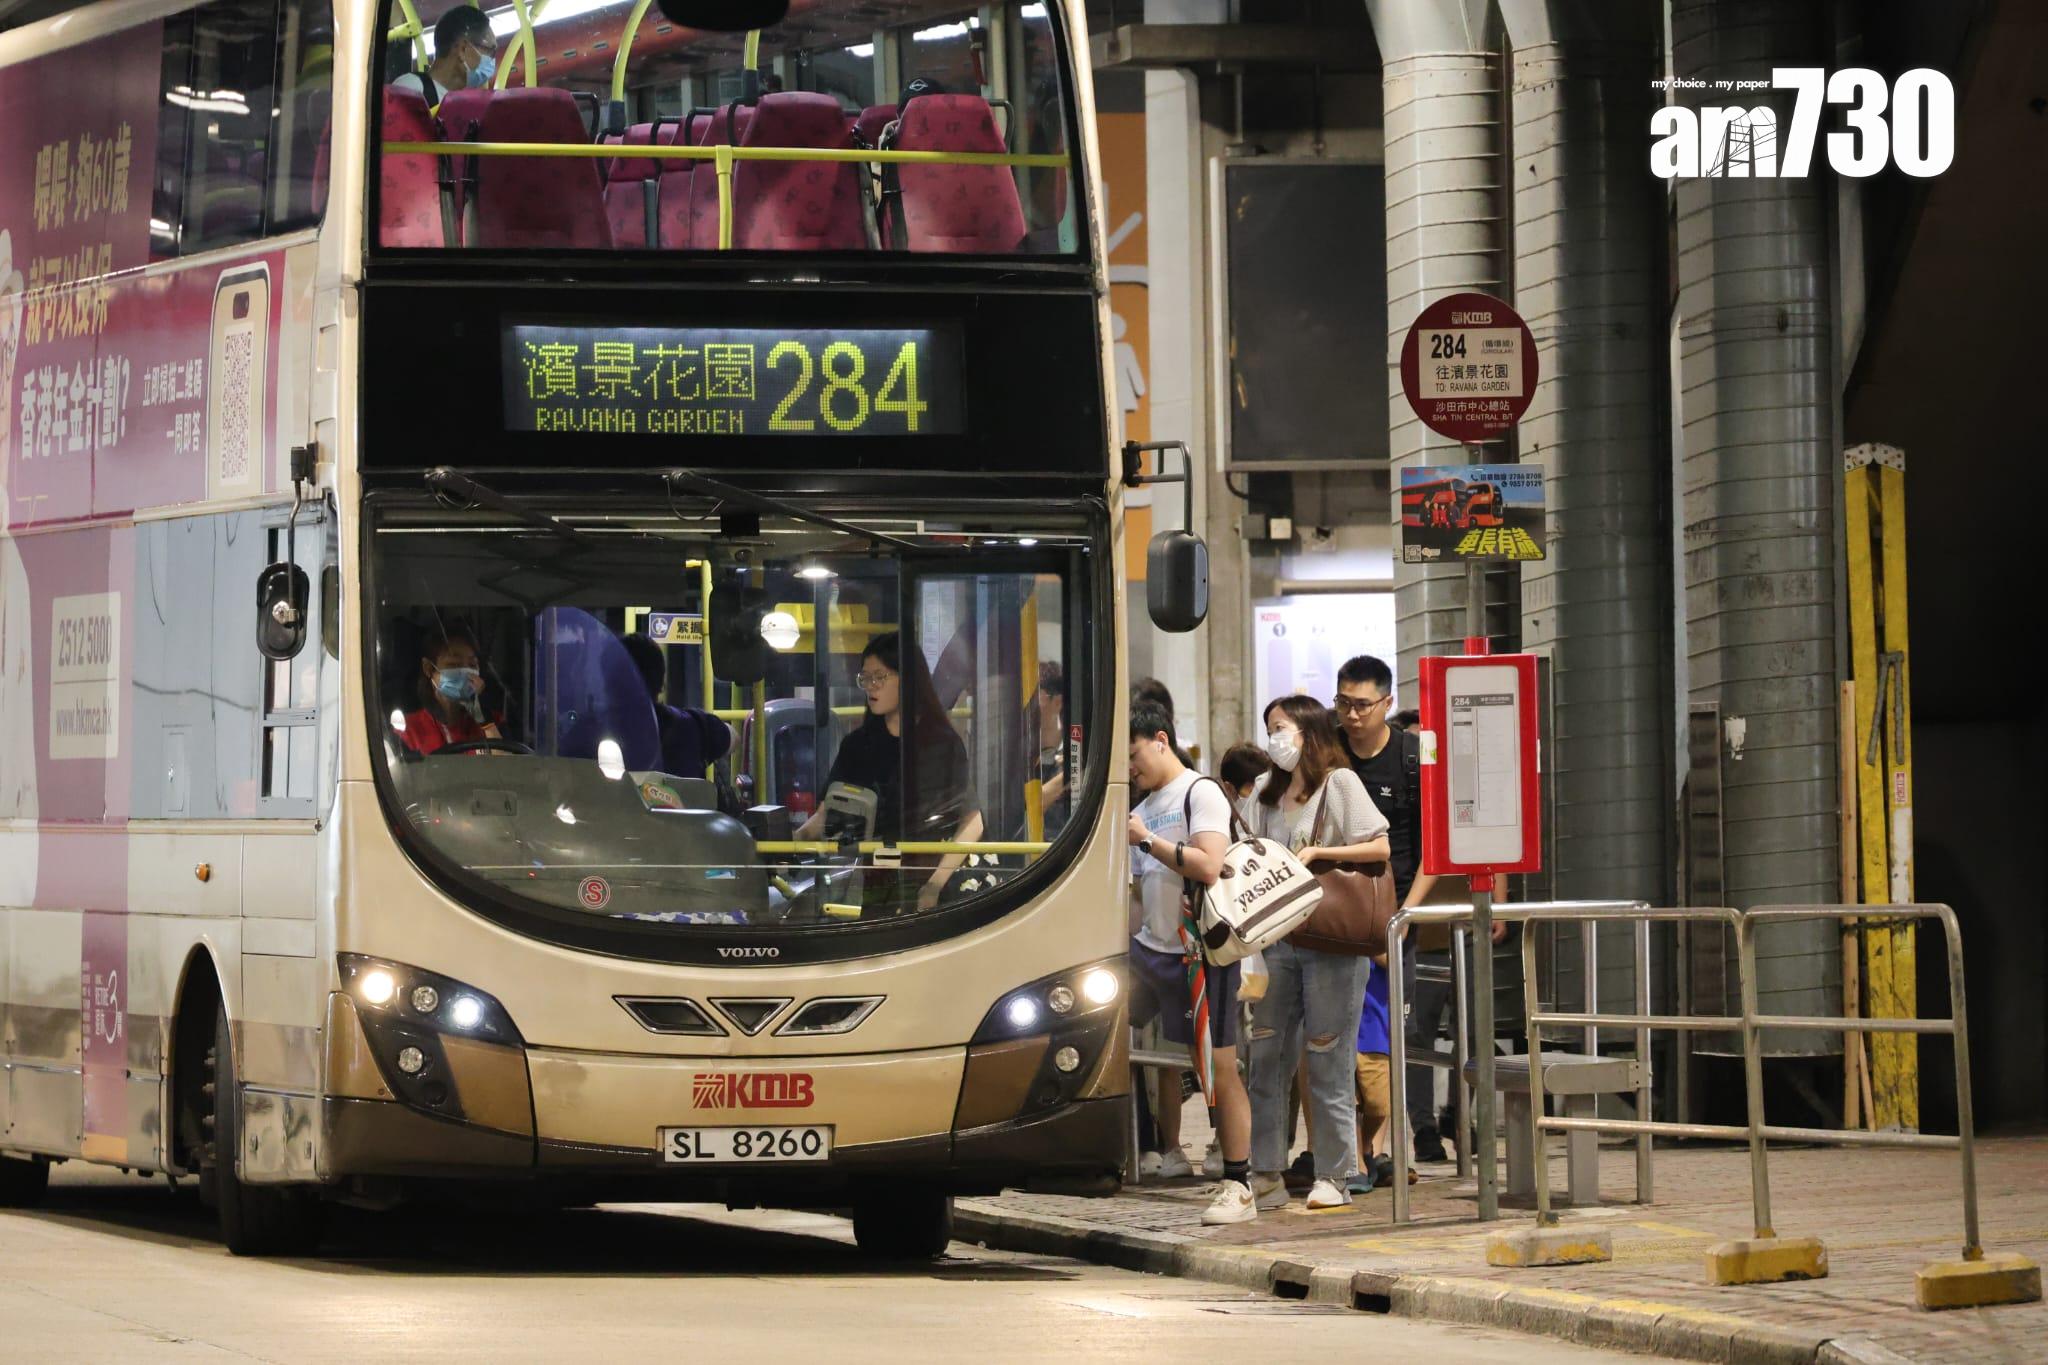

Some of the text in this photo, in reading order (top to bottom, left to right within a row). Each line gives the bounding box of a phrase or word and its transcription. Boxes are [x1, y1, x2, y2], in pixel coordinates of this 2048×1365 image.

[1463, 311, 1493, 324] KMB
[1431, 333, 1467, 359] 284
[522, 341, 756, 401] 濱景花園
[1436, 364, 1509, 380] 往濱景花園
[766, 340, 928, 431] 284
[1436, 381, 1510, 393] TO: RAVANA GARDEN
[1436, 400, 1510, 413] 沙田市中心總站
[1465, 413, 1499, 421] CENTRAL
[537, 408, 744, 433] RAVANA GARDEN
[58, 615, 112, 667] 2512 5000
[1454, 697, 1470, 706] 284
[55, 698, 112, 737] www.hkmca.hk
[1236, 861, 1295, 913] yasaki
[716, 947, 780, 958] VOLVO
[727, 1073, 815, 1109] KMB
[672, 1129, 822, 1160] SL 8260
